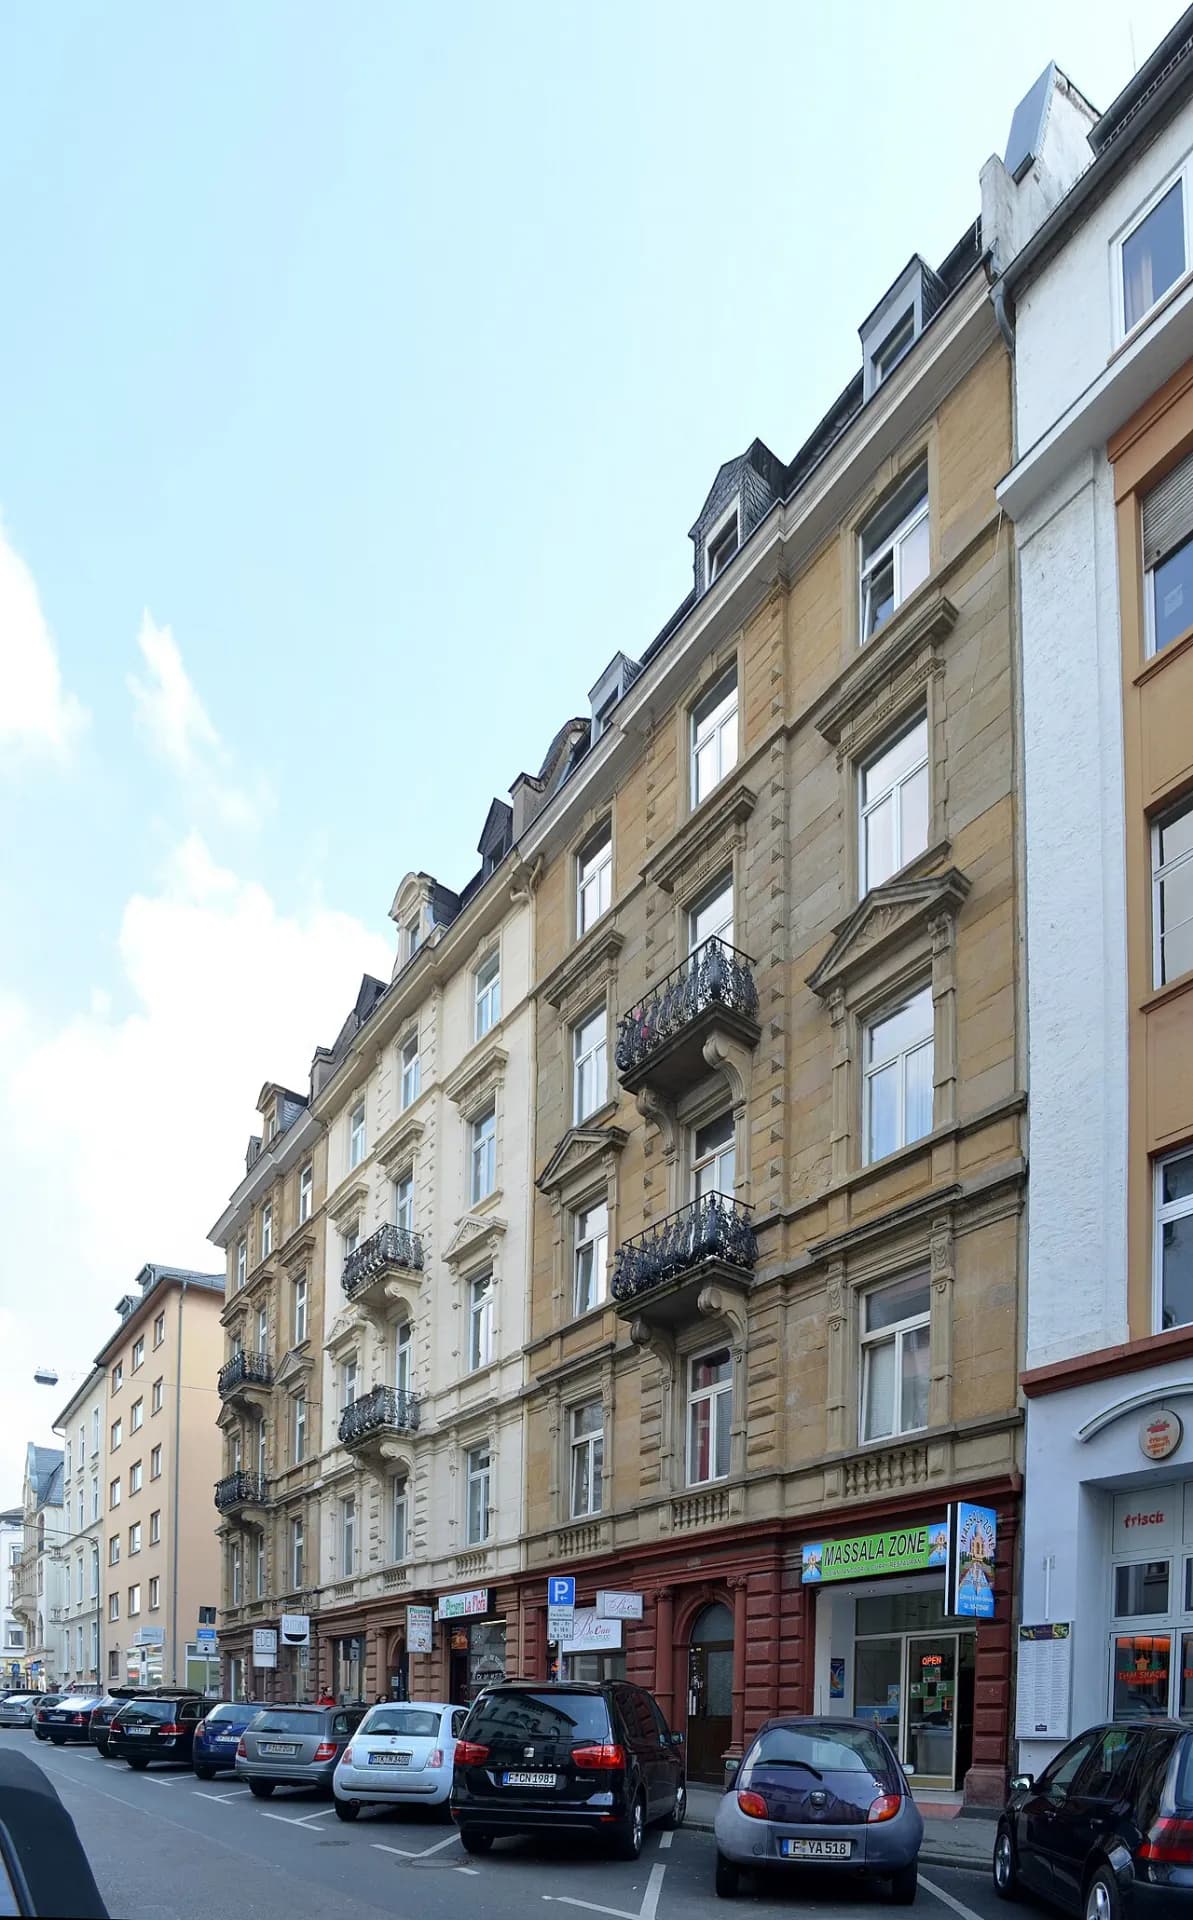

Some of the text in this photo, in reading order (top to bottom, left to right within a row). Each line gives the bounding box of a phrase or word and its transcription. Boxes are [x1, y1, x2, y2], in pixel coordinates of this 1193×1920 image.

[1124, 1511, 1165, 1528] frisch
[982, 1518, 996, 1550] ZONE
[824, 1531, 926, 1566] MASSALA ZONE
[554, 1581, 569, 1602] P
[921, 1655, 943, 1665] OPEN
[533, 1774, 554, 1784] 1981
[825, 1842, 846, 1855] 518
